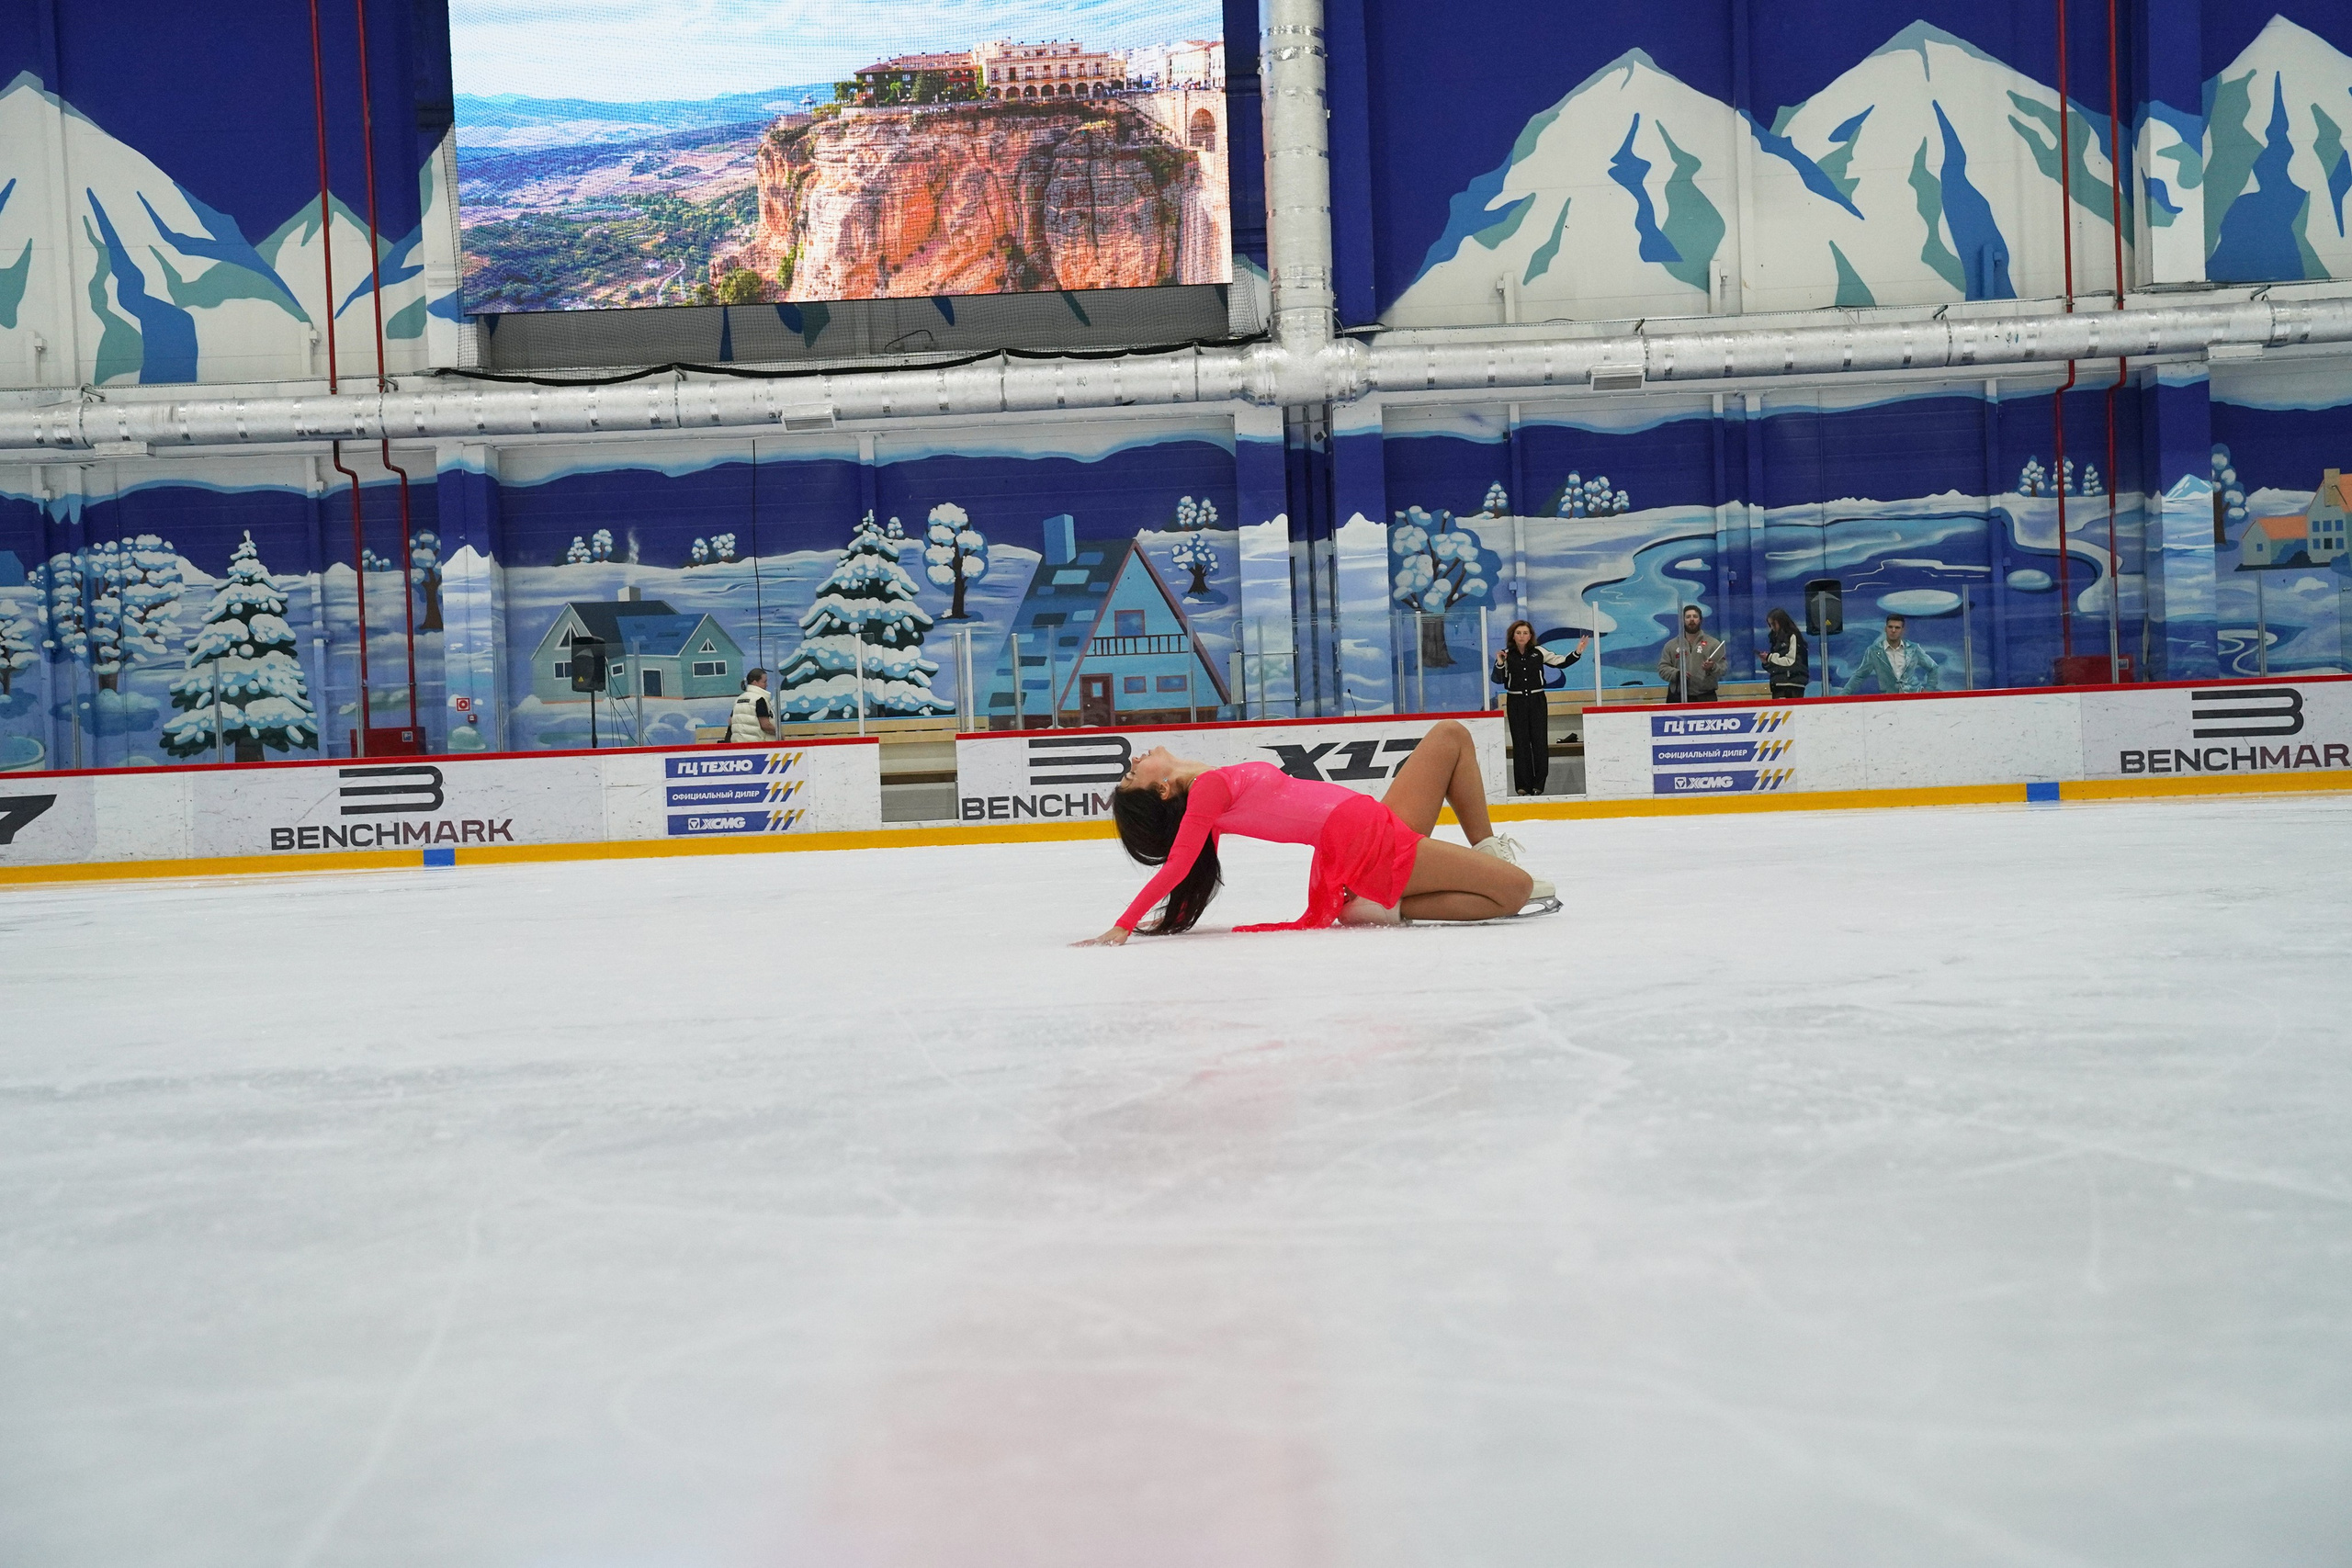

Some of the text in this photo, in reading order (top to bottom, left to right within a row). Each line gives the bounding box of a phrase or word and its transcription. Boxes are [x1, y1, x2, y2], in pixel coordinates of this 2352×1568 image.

[1664, 717, 1741, 735] ГЦ ТЕХНО
[1657, 749, 1747, 760] ОФИЦИАЛЬНЫЙ ДИЛЕР
[2120, 743, 2352, 774] BENCHMAR
[677, 759, 753, 775] ГЦ ТЕХНО
[1688, 775, 1734, 789] XCMG
[672, 789, 760, 801] ОФИЦИАЛЬНЫЙ ДИЛЕР
[961, 792, 1115, 820] BENCHM
[700, 817, 746, 829] XCMG
[270, 818, 514, 851] BENCHMARK
